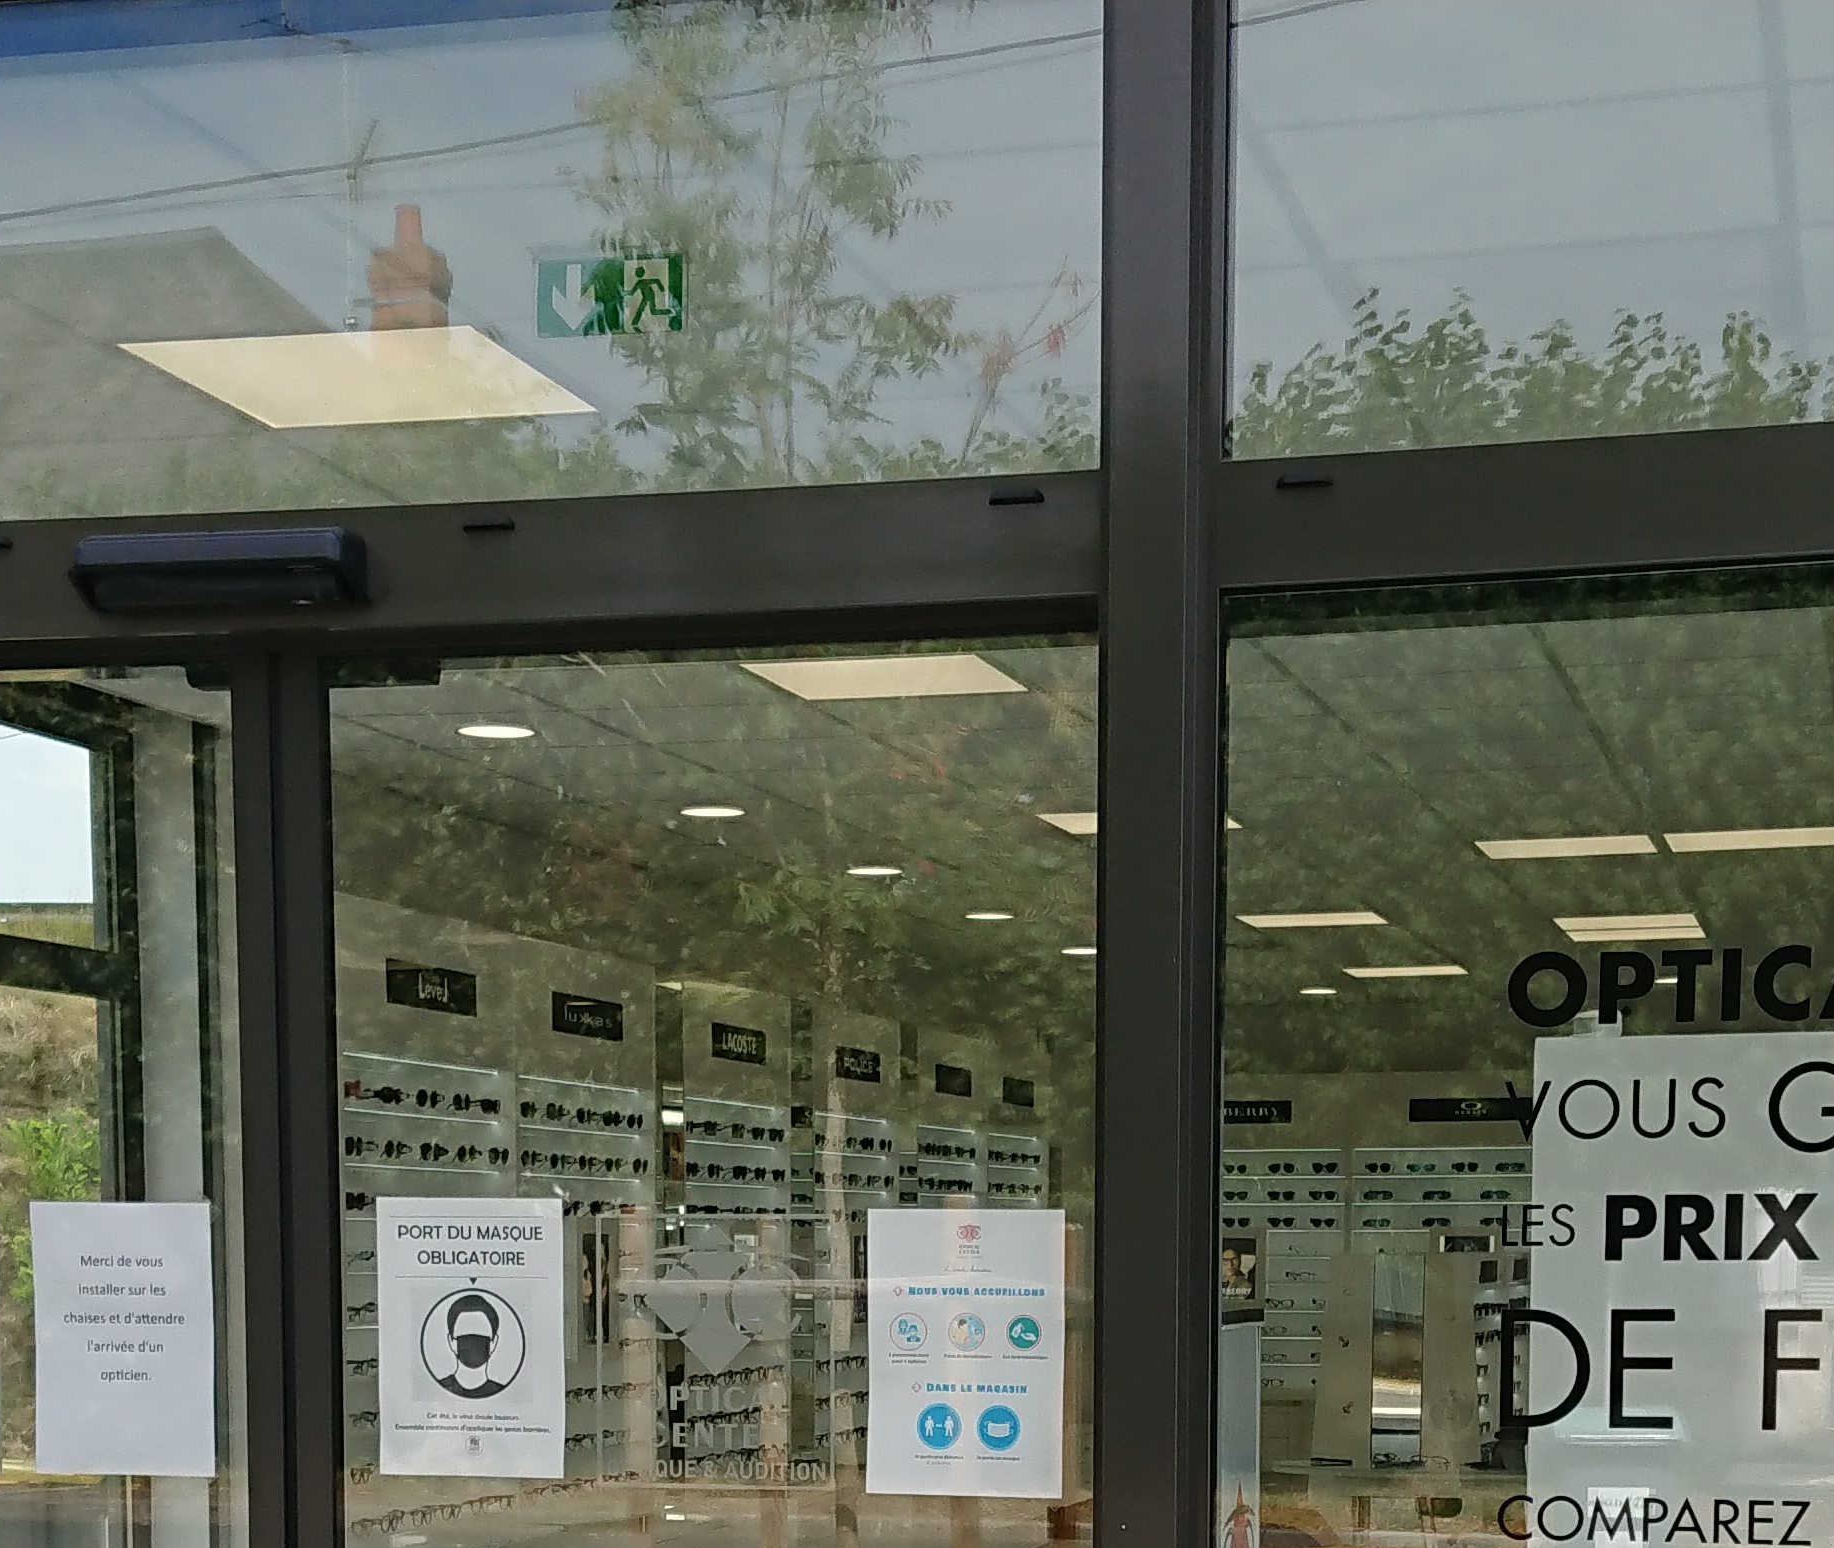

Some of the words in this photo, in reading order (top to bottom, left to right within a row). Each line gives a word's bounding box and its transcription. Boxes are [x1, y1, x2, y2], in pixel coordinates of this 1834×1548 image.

[721, 1031, 757, 1056] LACOSTE
[1503, 1075, 1728, 1143] VOUS
[398, 1225, 443, 1240] PORT
[448, 1226, 471, 1240] DU
[477, 1226, 543, 1242] MASQUE
[1500, 1203, 1577, 1249] LES
[1605, 1191, 1818, 1261] PRIX
[80, 1255, 114, 1268] Merci
[117, 1255, 132, 1268] de
[135, 1258, 163, 1268] vous
[417, 1250, 525, 1265] OBLIGATOIRE
[78, 1284, 125, 1296] installer
[128, 1286, 147, 1296] sur
[150, 1284, 166, 1296] les
[908, 1286, 937, 1296] NOUS
[942, 1287, 970, 1296] VOUS
[974, 1287, 1045, 1297] ACCUEILLONS
[63, 1312, 106, 1324] chaises
[109, 1314, 121, 1324] et
[124, 1312, 185, 1325] d'attendre
[87, 1340, 135, 1352] l'arrivée
[138, 1341, 164, 1353] d'un
[100, 1369, 152, 1382] opticien.
[1499, 1308, 1676, 1430] DE
[926, 1383, 957, 1392] DANS
[960, 1384, 973, 1392] LE
[976, 1385, 1028, 1394] MAGASIN
[725, 1461, 826, 1481] AUDITION
[1498, 1494, 1811, 1546] COMPAREZ
